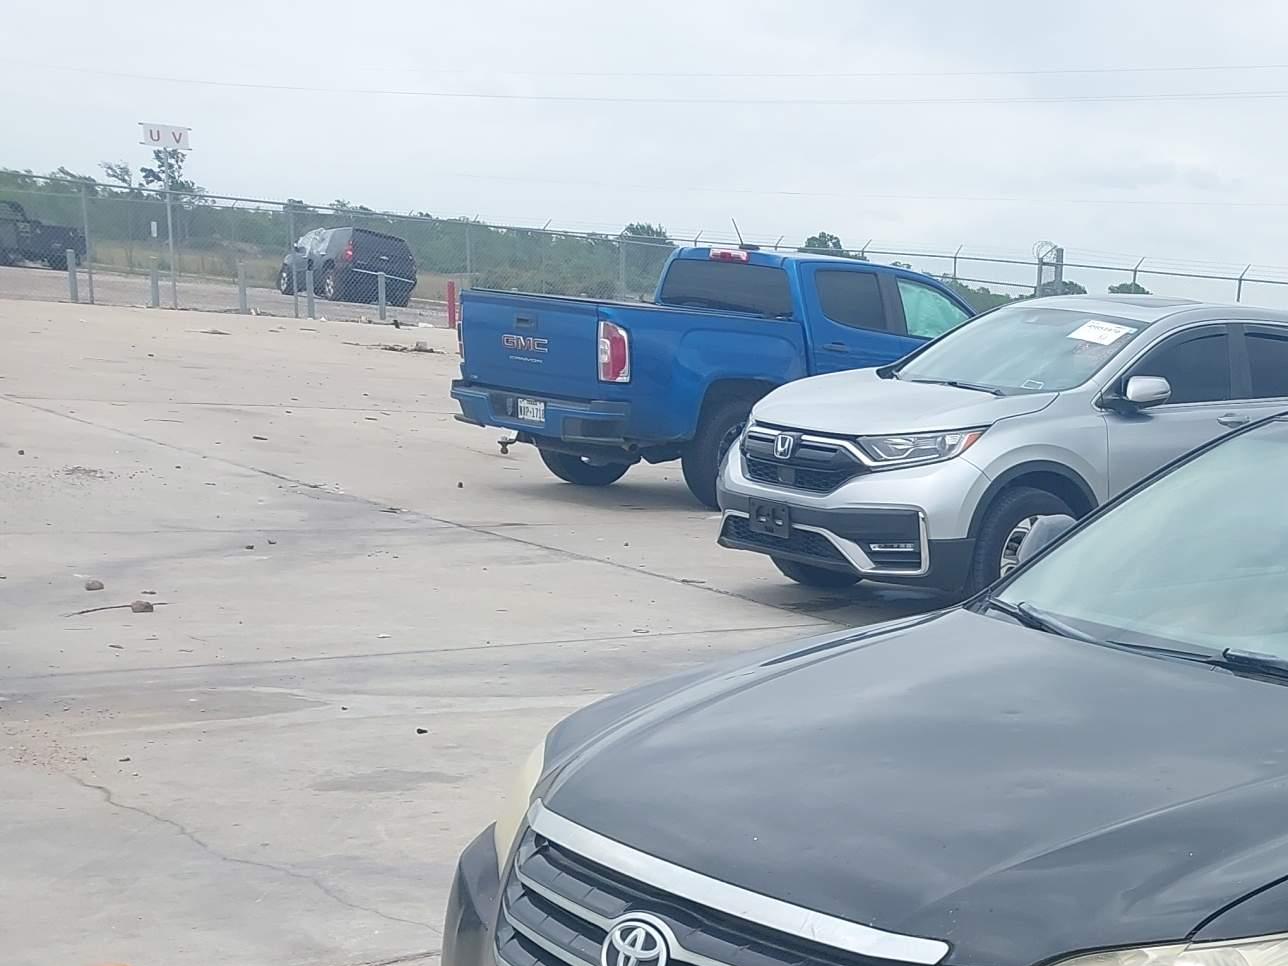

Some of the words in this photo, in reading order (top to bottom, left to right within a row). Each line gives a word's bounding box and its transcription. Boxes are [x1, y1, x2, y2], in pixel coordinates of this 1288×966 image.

[150, 129, 160, 142] U
[171, 131, 183, 144] V
[502, 334, 548, 353] GMC
